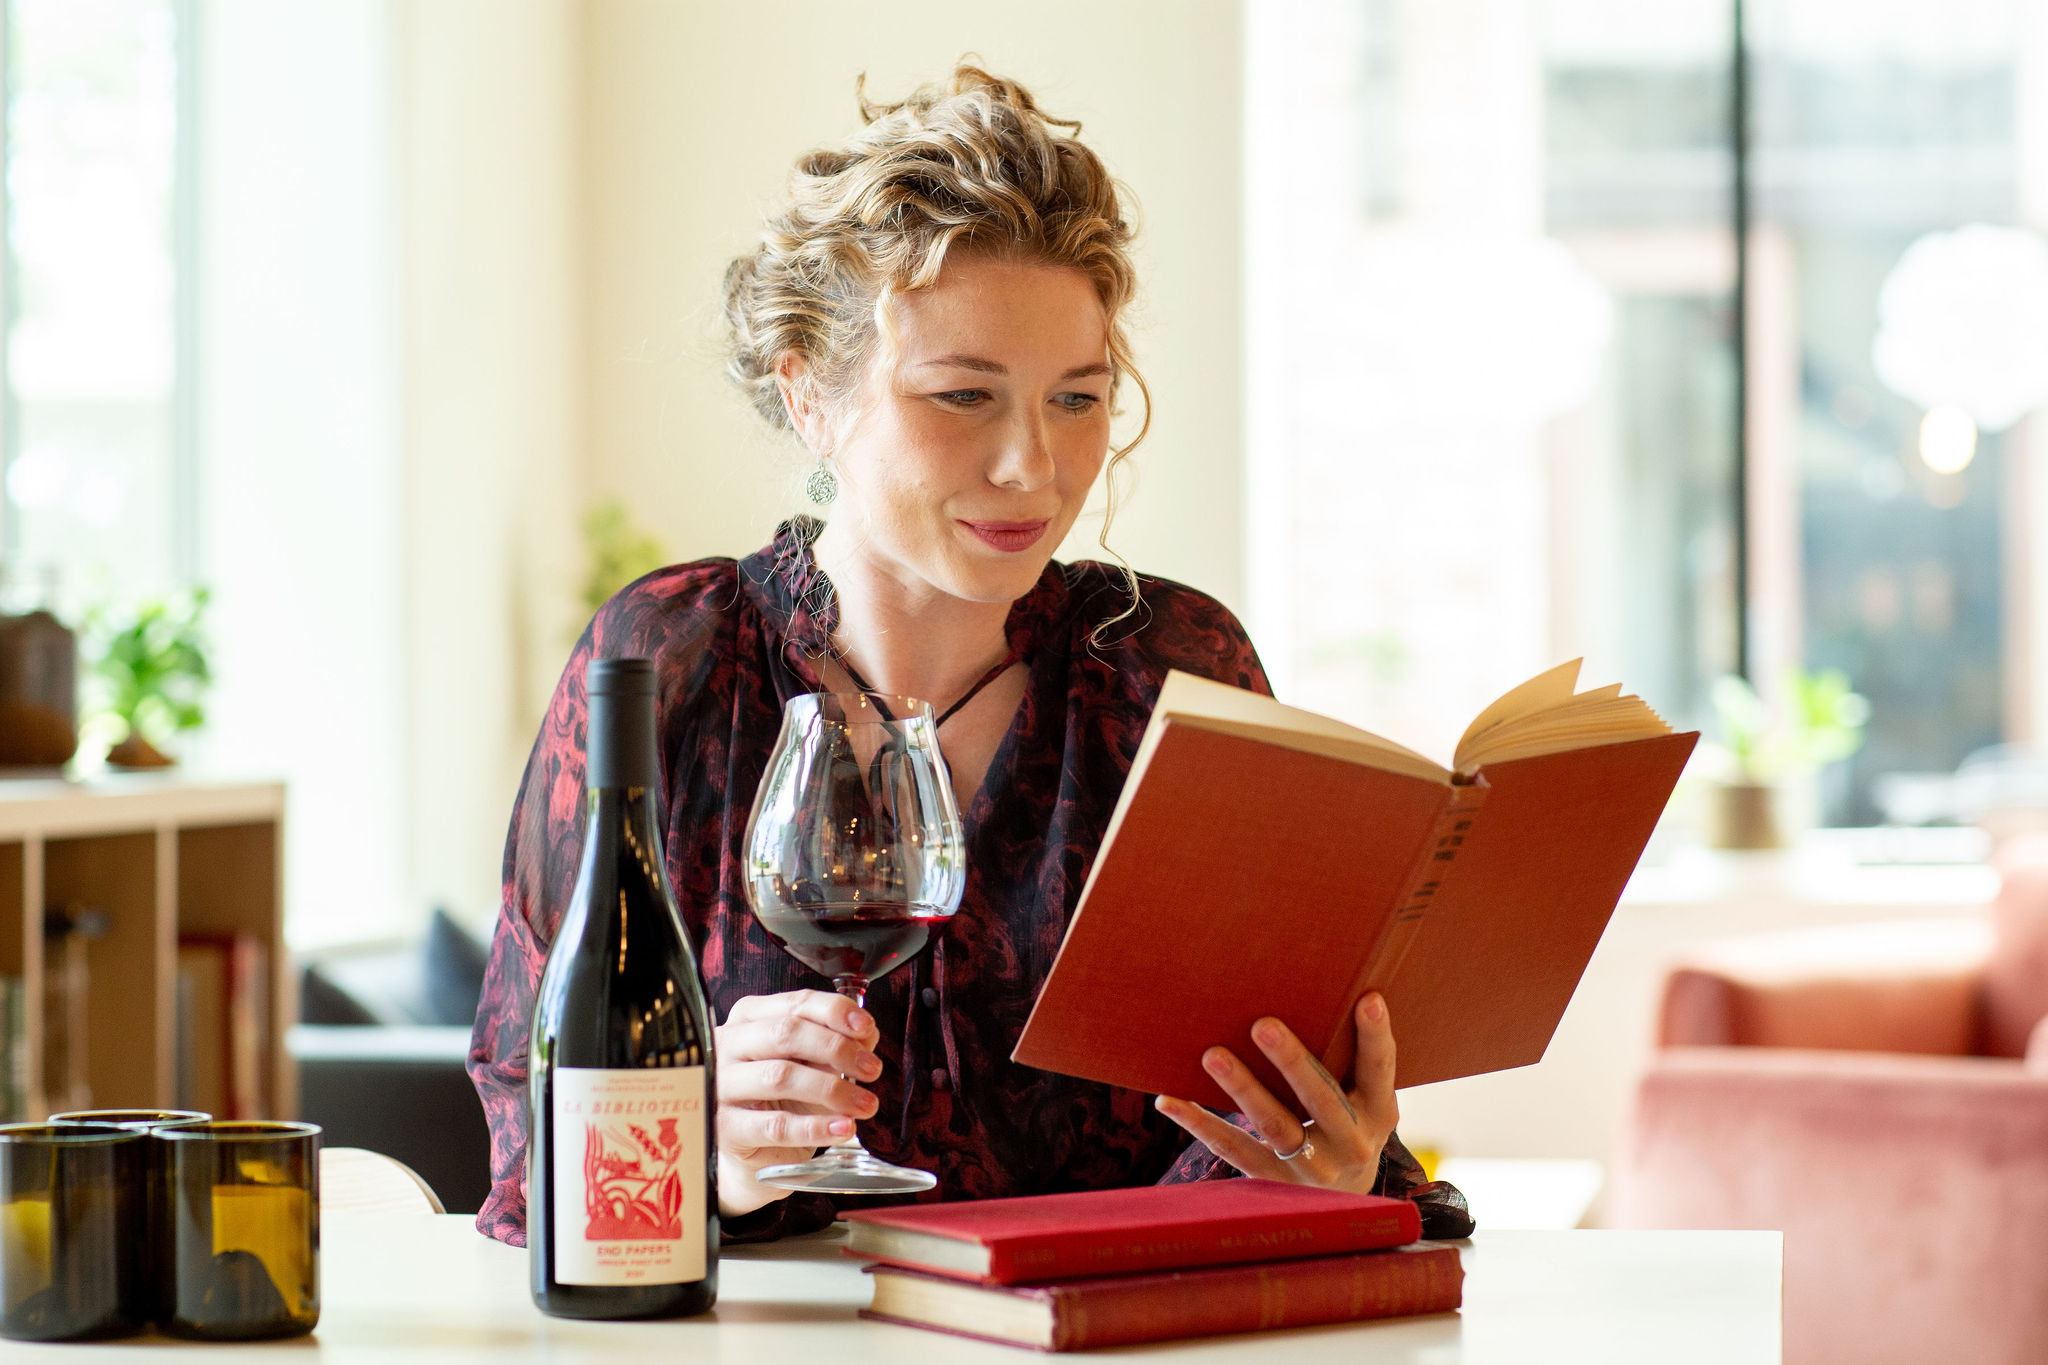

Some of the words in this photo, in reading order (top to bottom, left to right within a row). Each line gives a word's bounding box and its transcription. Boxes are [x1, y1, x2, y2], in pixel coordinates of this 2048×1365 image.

[591, 1098, 700, 1114] BIBLIOTECA
[597, 1245, 622, 1256] END
[625, 1243, 671, 1256] PAPERS
